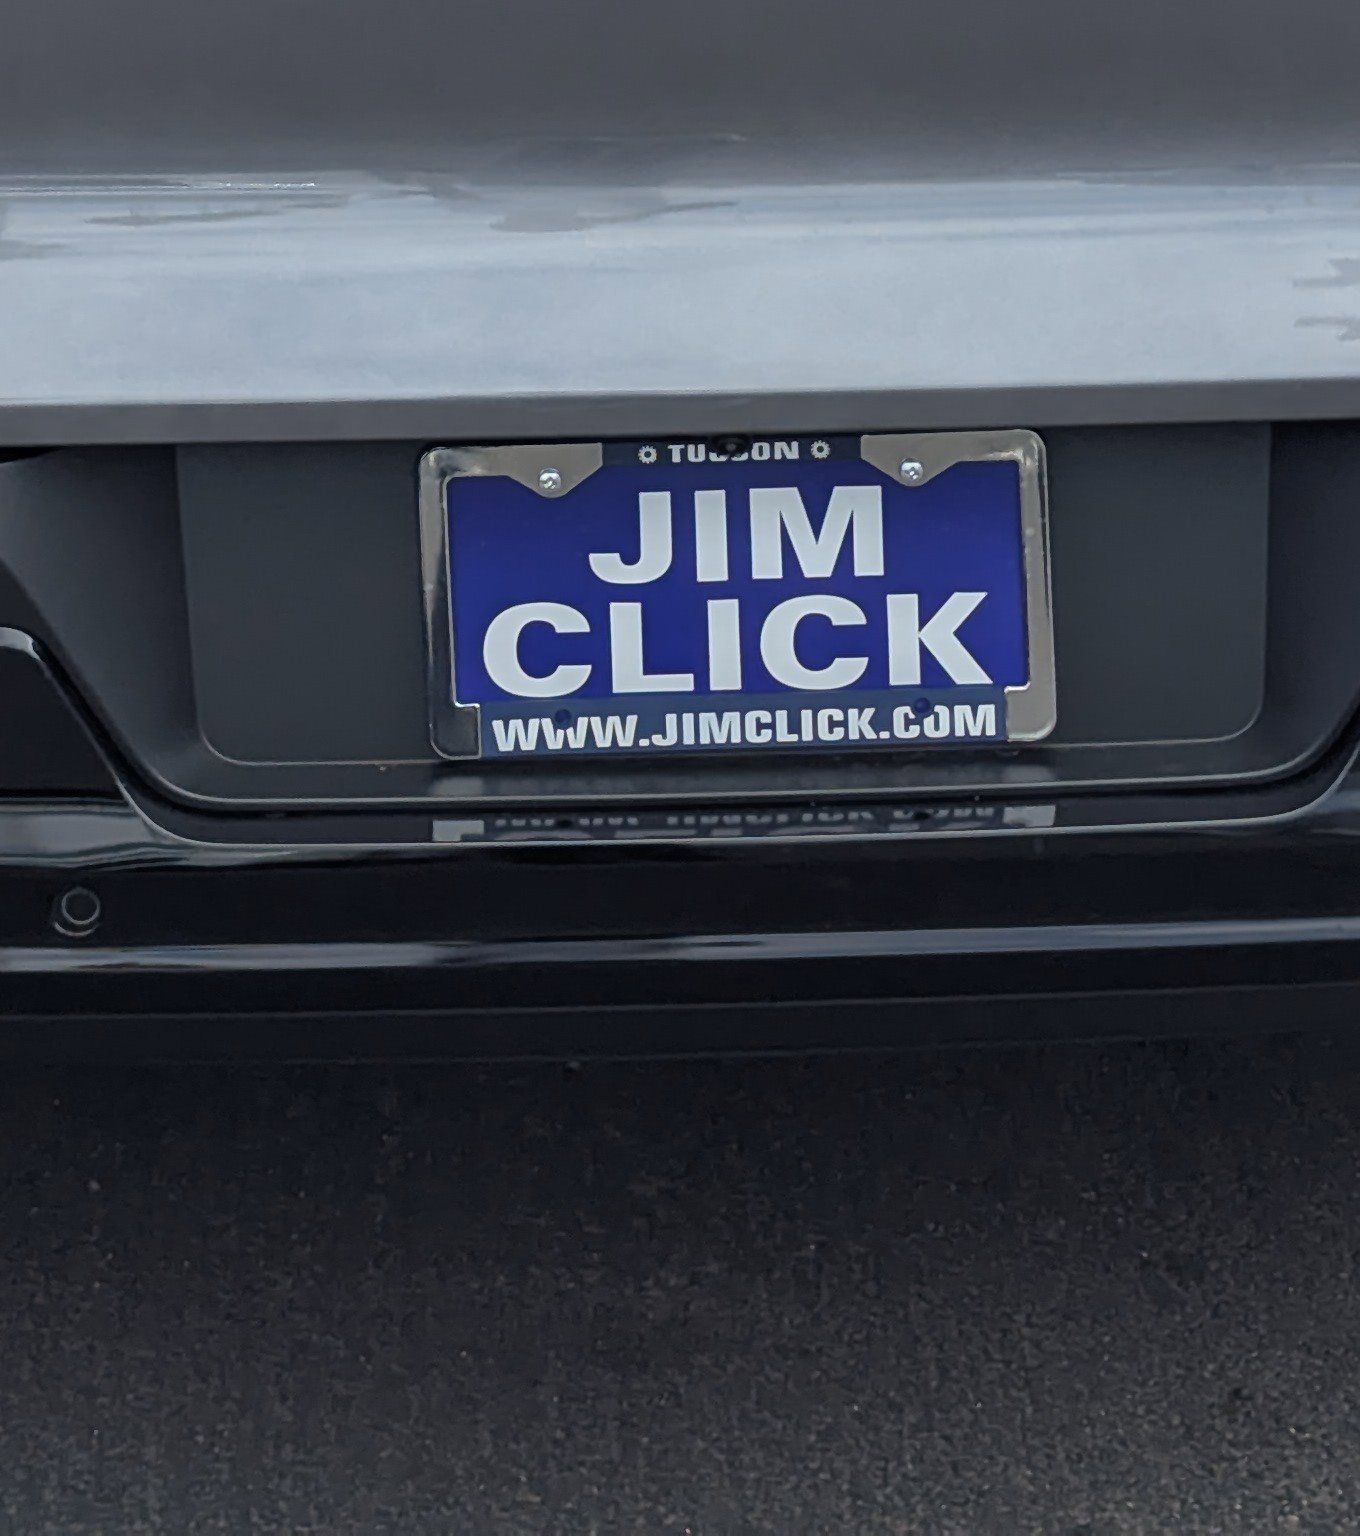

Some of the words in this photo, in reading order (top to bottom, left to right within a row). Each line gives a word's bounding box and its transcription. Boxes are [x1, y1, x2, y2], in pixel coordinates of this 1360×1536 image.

[588, 484, 885, 585] JIM
[482, 591, 994, 699] CLICK
[491, 702, 998, 753] WWW.JIMCLICK.COM
